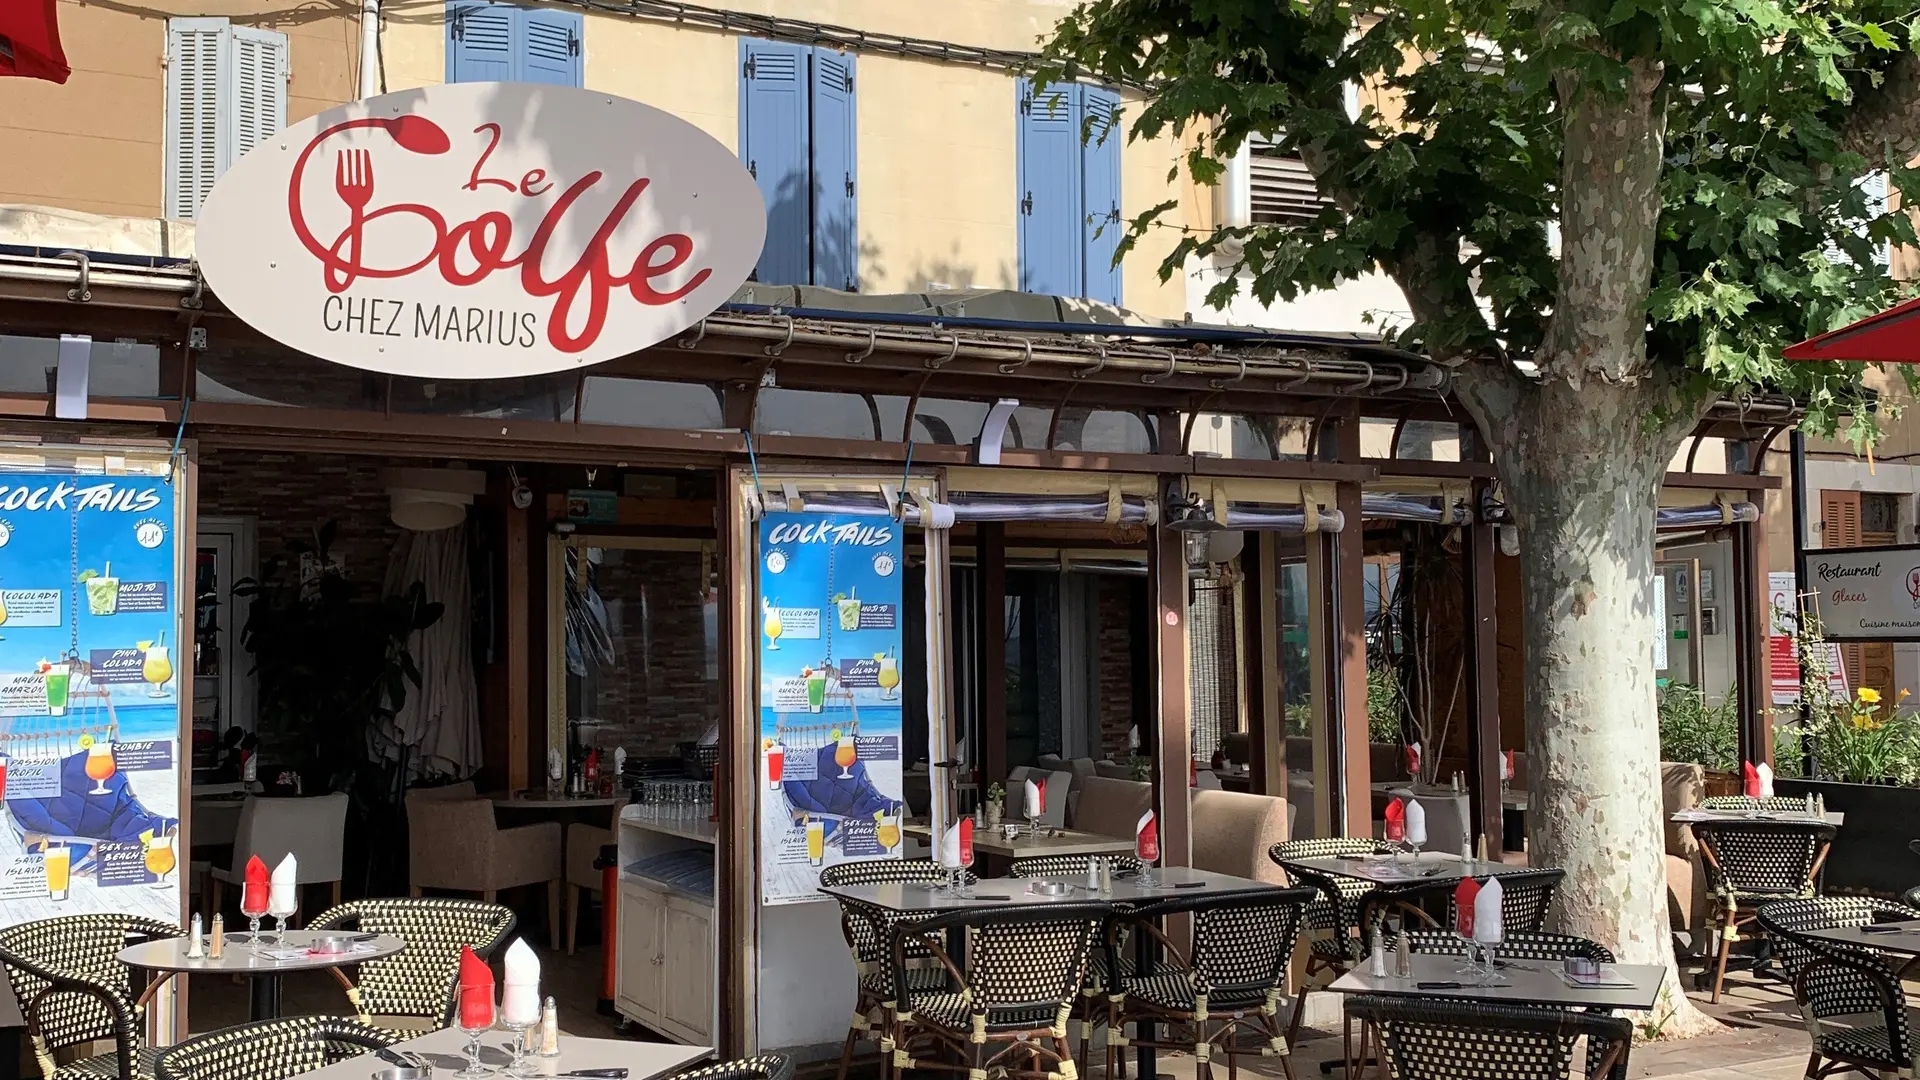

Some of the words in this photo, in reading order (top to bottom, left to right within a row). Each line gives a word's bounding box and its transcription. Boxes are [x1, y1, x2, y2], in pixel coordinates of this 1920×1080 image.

[461, 122, 555, 198] Le
[288, 115, 713, 354] Golfe
[322, 295, 404, 338] CHEZ
[414, 301, 537, 349] MARIUS
[768, 519, 893, 547] COCKTAILS
[1817, 561, 1883, 583] Restaurant
[5, 592, 59, 600] COCOLADA
[1831, 587, 1868, 606] Glaces
[1859, 617, 1890, 629] Cuisine
[103, 658, 143, 669] COLADA
[849, 666, 878, 675] COLADA
[12, 676, 45, 685] MAGIC
[1, 685, 46, 695] AMAZON
[854, 736, 885, 745] ZOMBIE
[113, 742, 155, 752] ZOMBIE
[10, 757, 59, 767] PASSION
[8, 768, 43, 778] TROPIC
[844, 819, 861, 828] SEX
[847, 827, 874, 836] BEACH
[98, 842, 124, 853] SEX
[14, 856, 44, 866] SAND
[103, 852, 140, 863] BEACH
[5, 866, 45, 877] ISLAND
